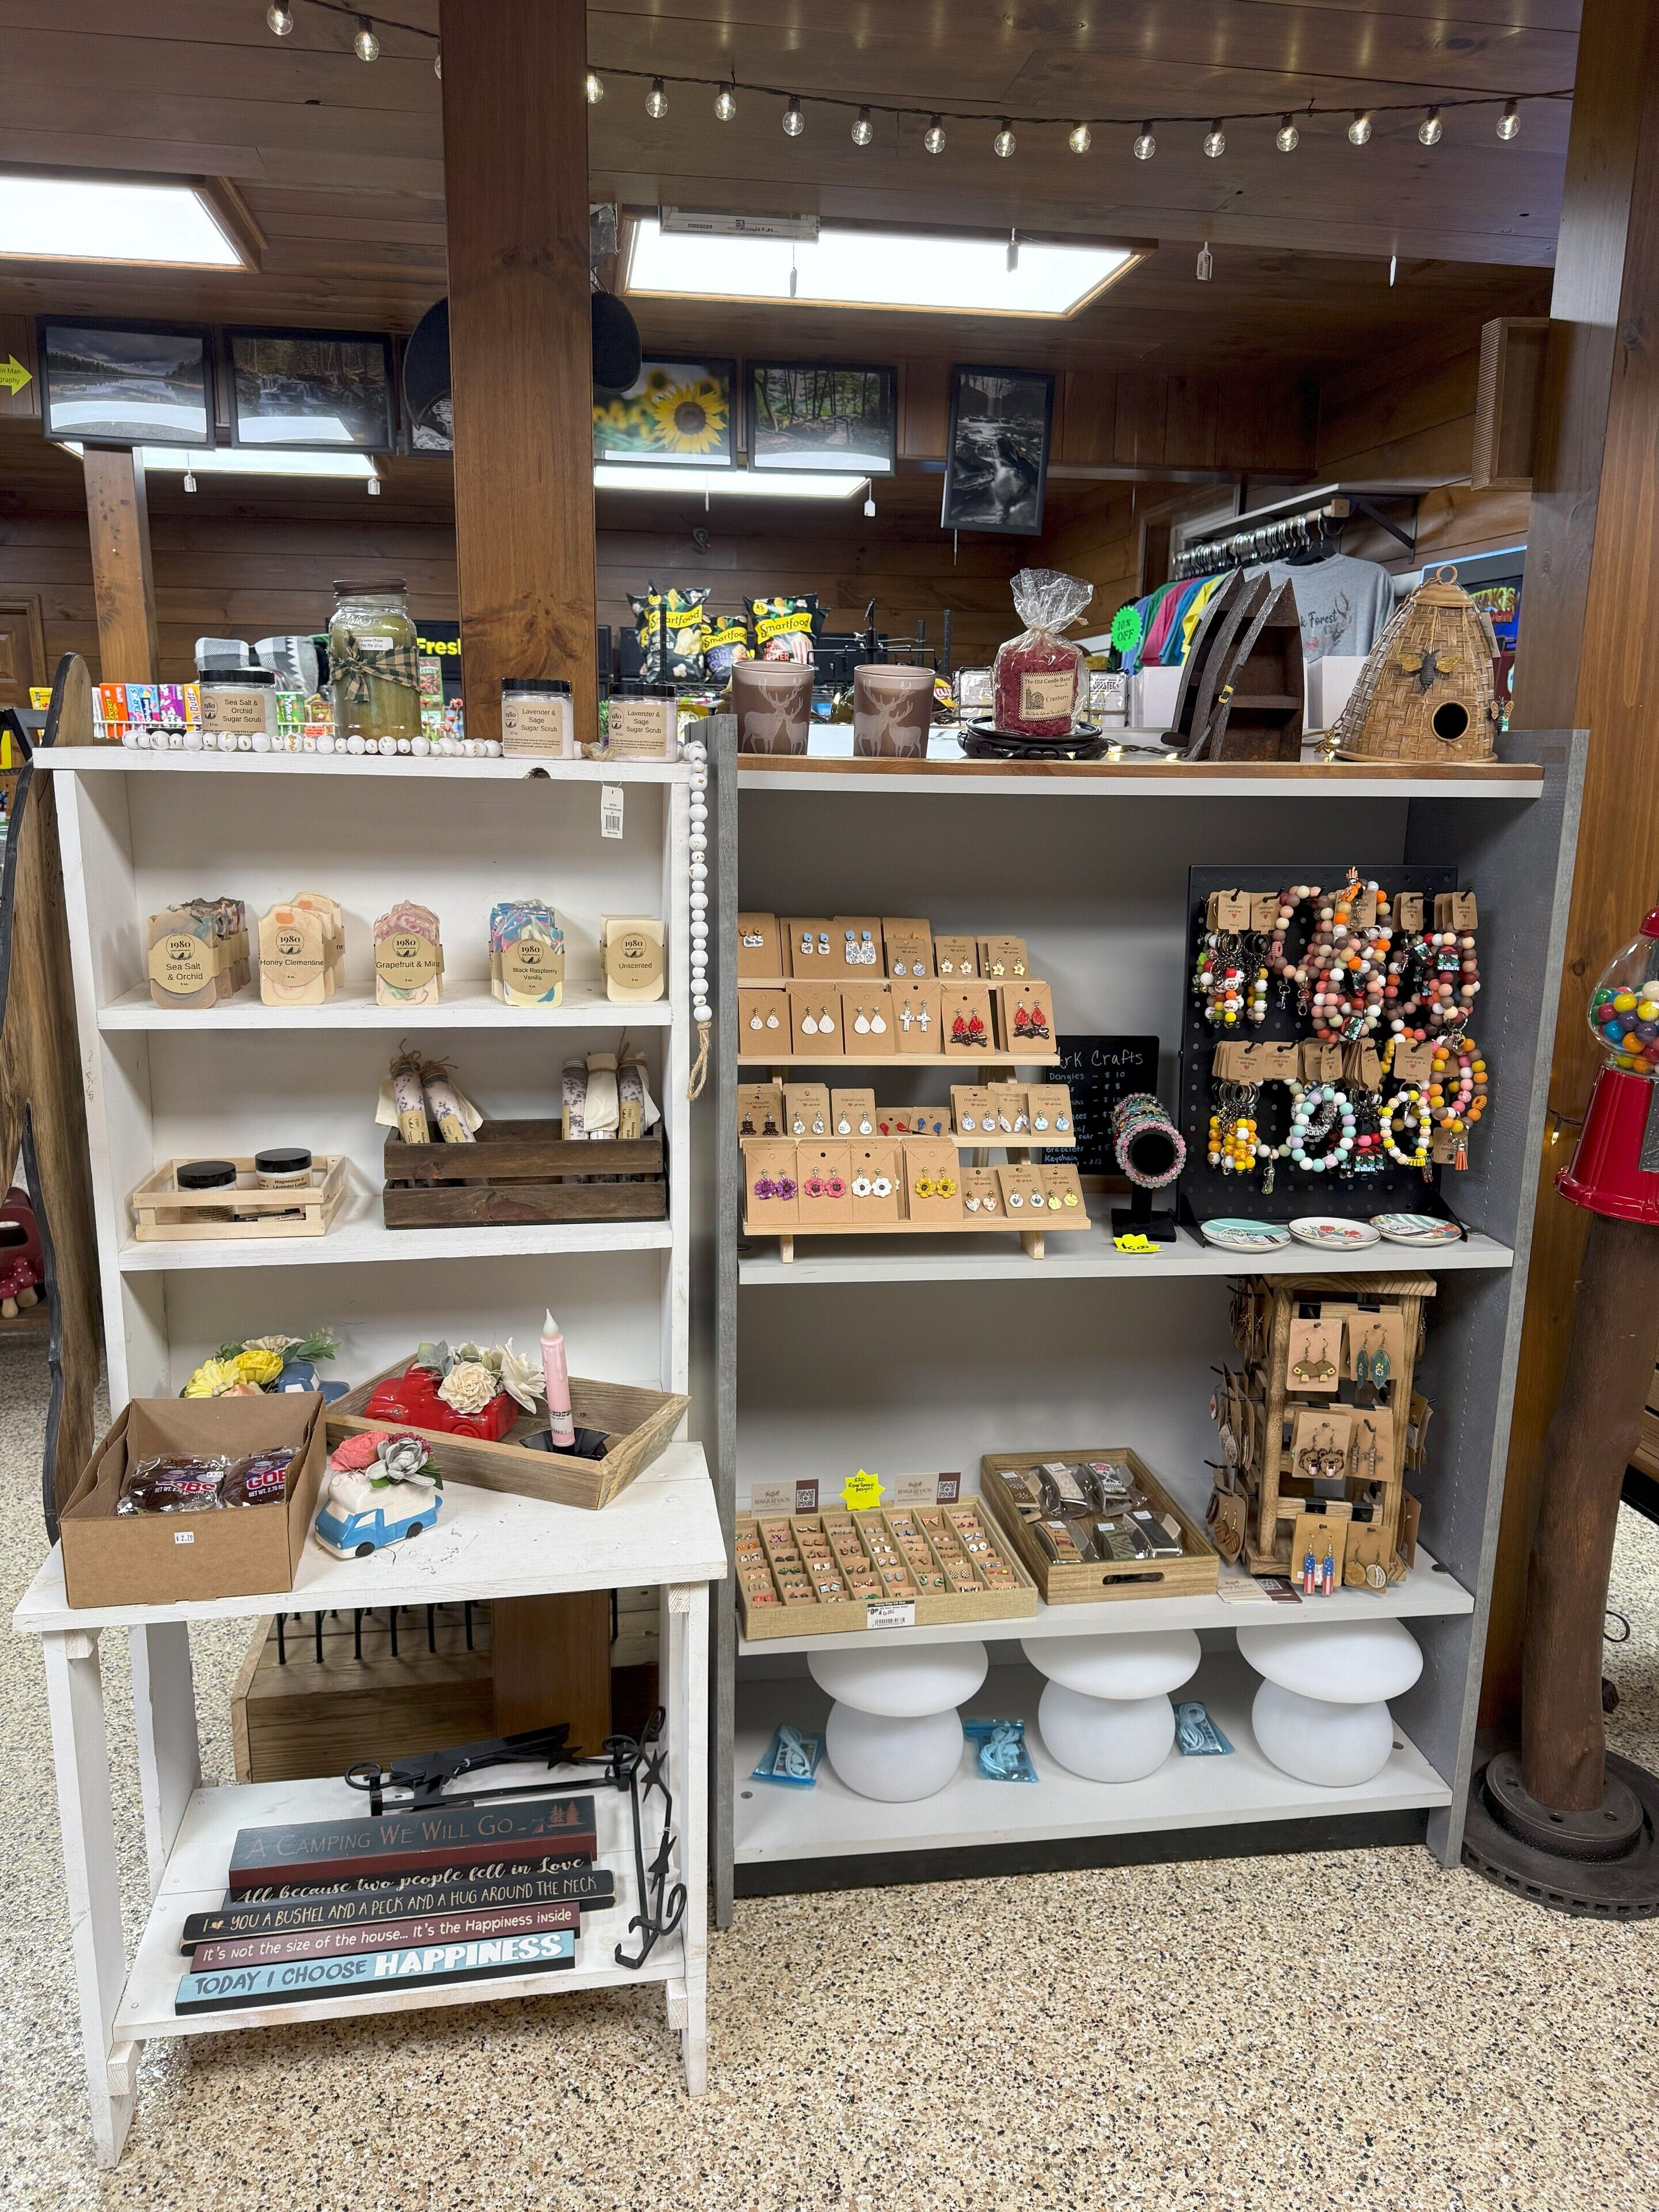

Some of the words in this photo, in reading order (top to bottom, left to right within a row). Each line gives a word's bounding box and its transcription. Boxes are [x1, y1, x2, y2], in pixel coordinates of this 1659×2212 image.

[1118, 619, 1131, 631] 10%
[1308, 609, 1337, 628] Forest
[760, 618, 810, 638] Smartfood
[1118, 629, 1134, 642] OFF
[171, 941, 191, 949] 1980
[280, 935, 300, 944] 1980
[396, 938, 416, 948] 1980
[521, 945, 540, 953] 1980
[376, 961, 414, 969] Grapefruit
[1092, 1050, 1143, 1066] Crafts
[1049, 1073, 1085, 1084] Dangles
[1045, 1154, 1078, 1164] Keychain
[247, 1468, 285, 1490] GOB
[246, 1839, 266, 1859] A
[276, 1833, 370, 1857] CAMPING
[422, 1819, 469, 1842] WILL
[233, 1887, 274, 1905] All
[279, 1882, 351, 1899] because
[356, 1878, 395, 1891] two
[396, 1869, 464, 1892] people
[469, 1862, 505, 1881] fell
[511, 1863, 532, 1875] in
[537, 1857, 584, 1874] Love
[203, 1918, 209, 1932] I
[230, 1914, 259, 1930] YOU
[262, 1912, 271, 1926] A
[274, 1907, 324, 1927] BUSHEL
[328, 1903, 355, 1919] AND
[359, 1902, 368, 1916] A
[372, 1897, 403, 1916] PECK
[407, 1894, 434, 1911] AND
[438, 1892, 447, 1907] A
[450, 1889, 478, 1904] HUG
[481, 1884, 533, 1902] AROUND
[536, 1880, 558, 1896] THE
[563, 1876, 597, 1894] NECK
[203, 1946, 226, 1961] It's
[260, 1941, 282, 1955] the
[286, 1939, 310, 1952] size
[315, 1935, 331, 1949] of
[336, 1933, 357, 1947] the
[361, 1930, 408, 1945] house...
[413, 1923, 434, 1938] It's
[440, 1921, 460, 1934] the
[195, 1970, 261, 1995] TODAY
[267, 1971, 275, 1987] I
[281, 1959, 368, 1986] CHOOSE
[373, 1934, 563, 1978] HAPPINESS
